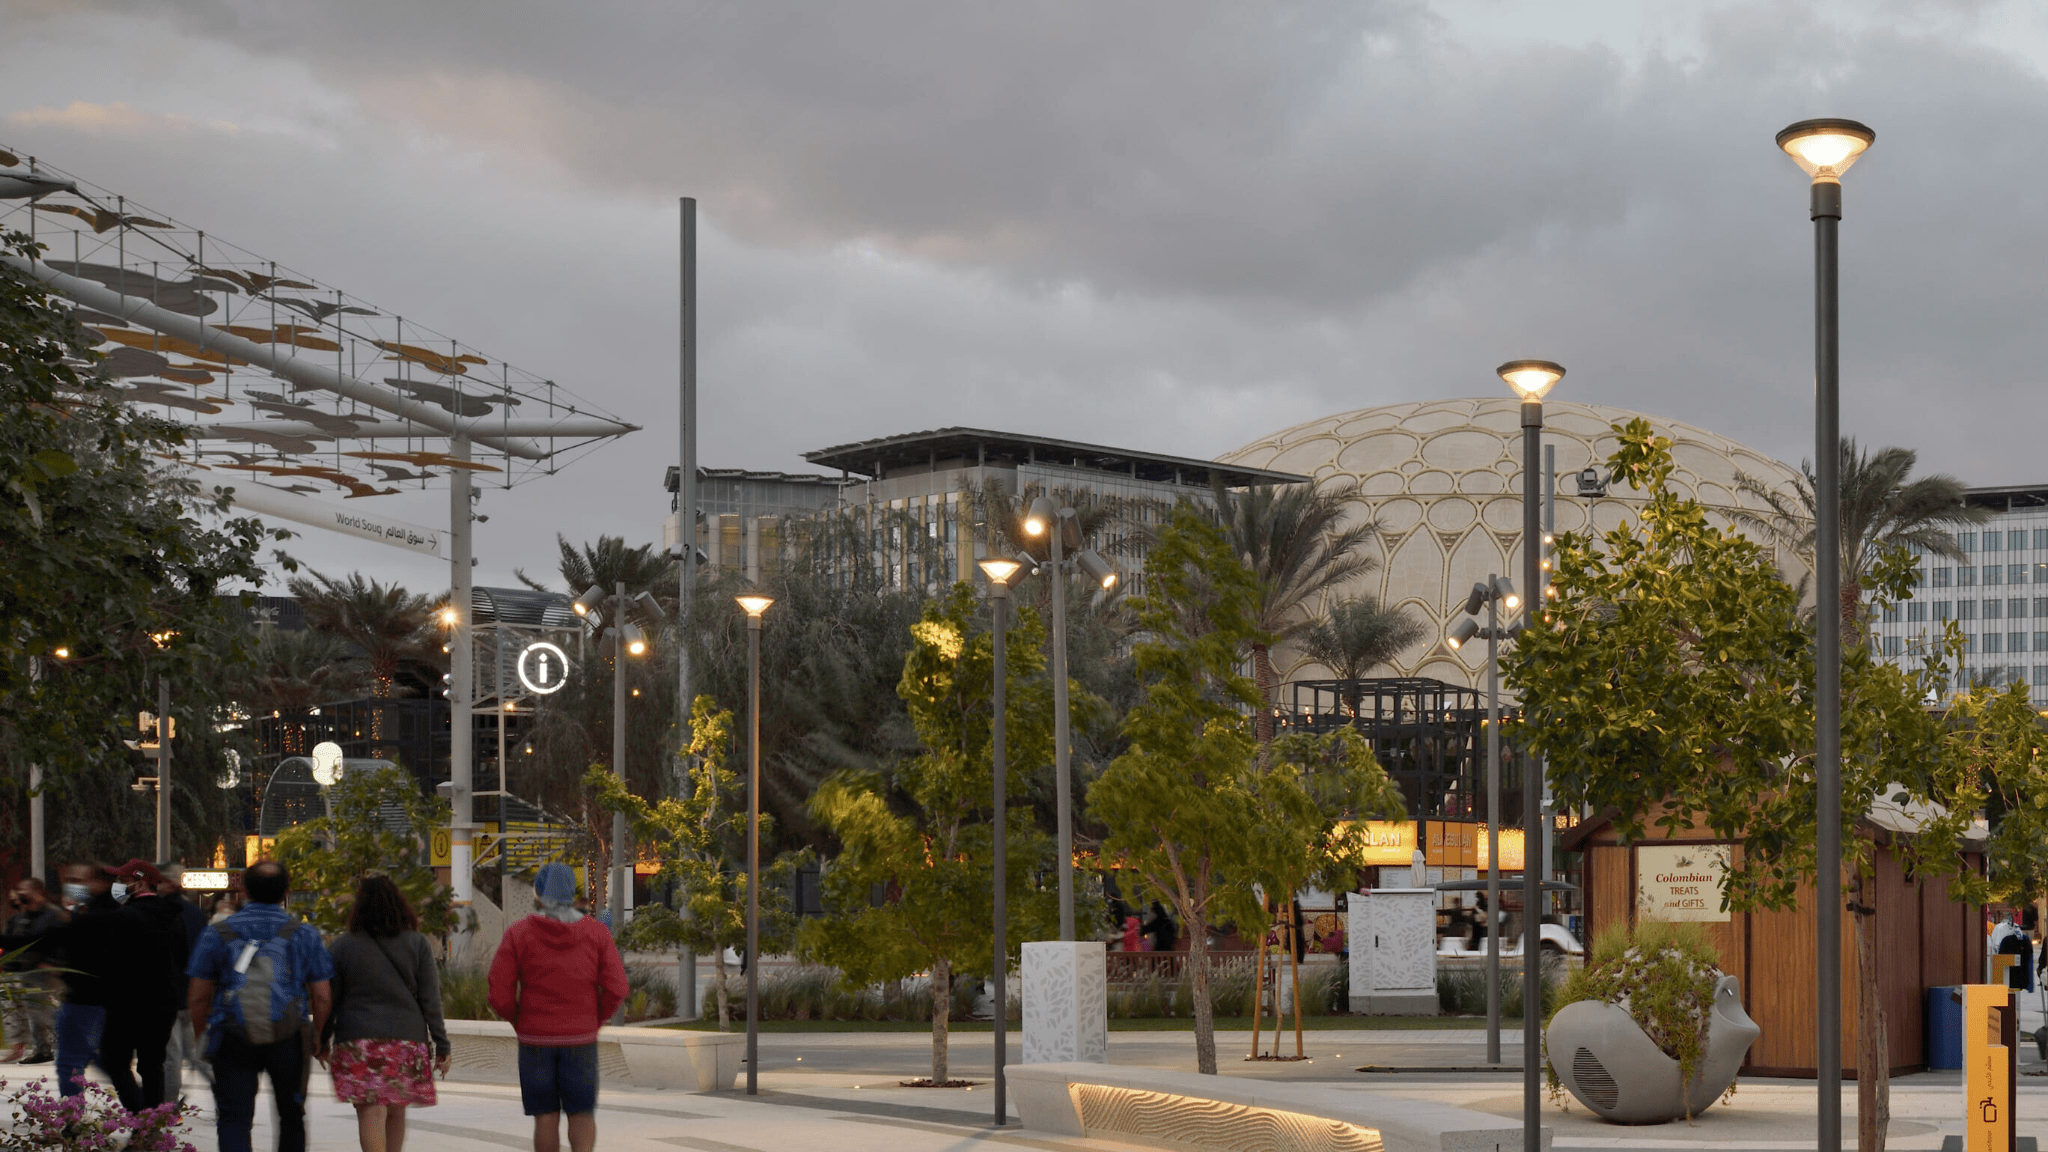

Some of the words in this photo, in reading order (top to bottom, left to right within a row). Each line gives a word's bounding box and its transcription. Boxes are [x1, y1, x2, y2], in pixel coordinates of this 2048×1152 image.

[336, 512, 361, 529] World
[362, 519, 383, 537] Souq
[385, 526, 406, 540] العالم
[407, 530, 425, 546] سوق
[1655, 872, 1713, 883] Colombian
[1669, 886, 1699, 895] TREATS
[1664, 899, 1681, 908] and
[1682, 899, 1705, 908] GIFTS
